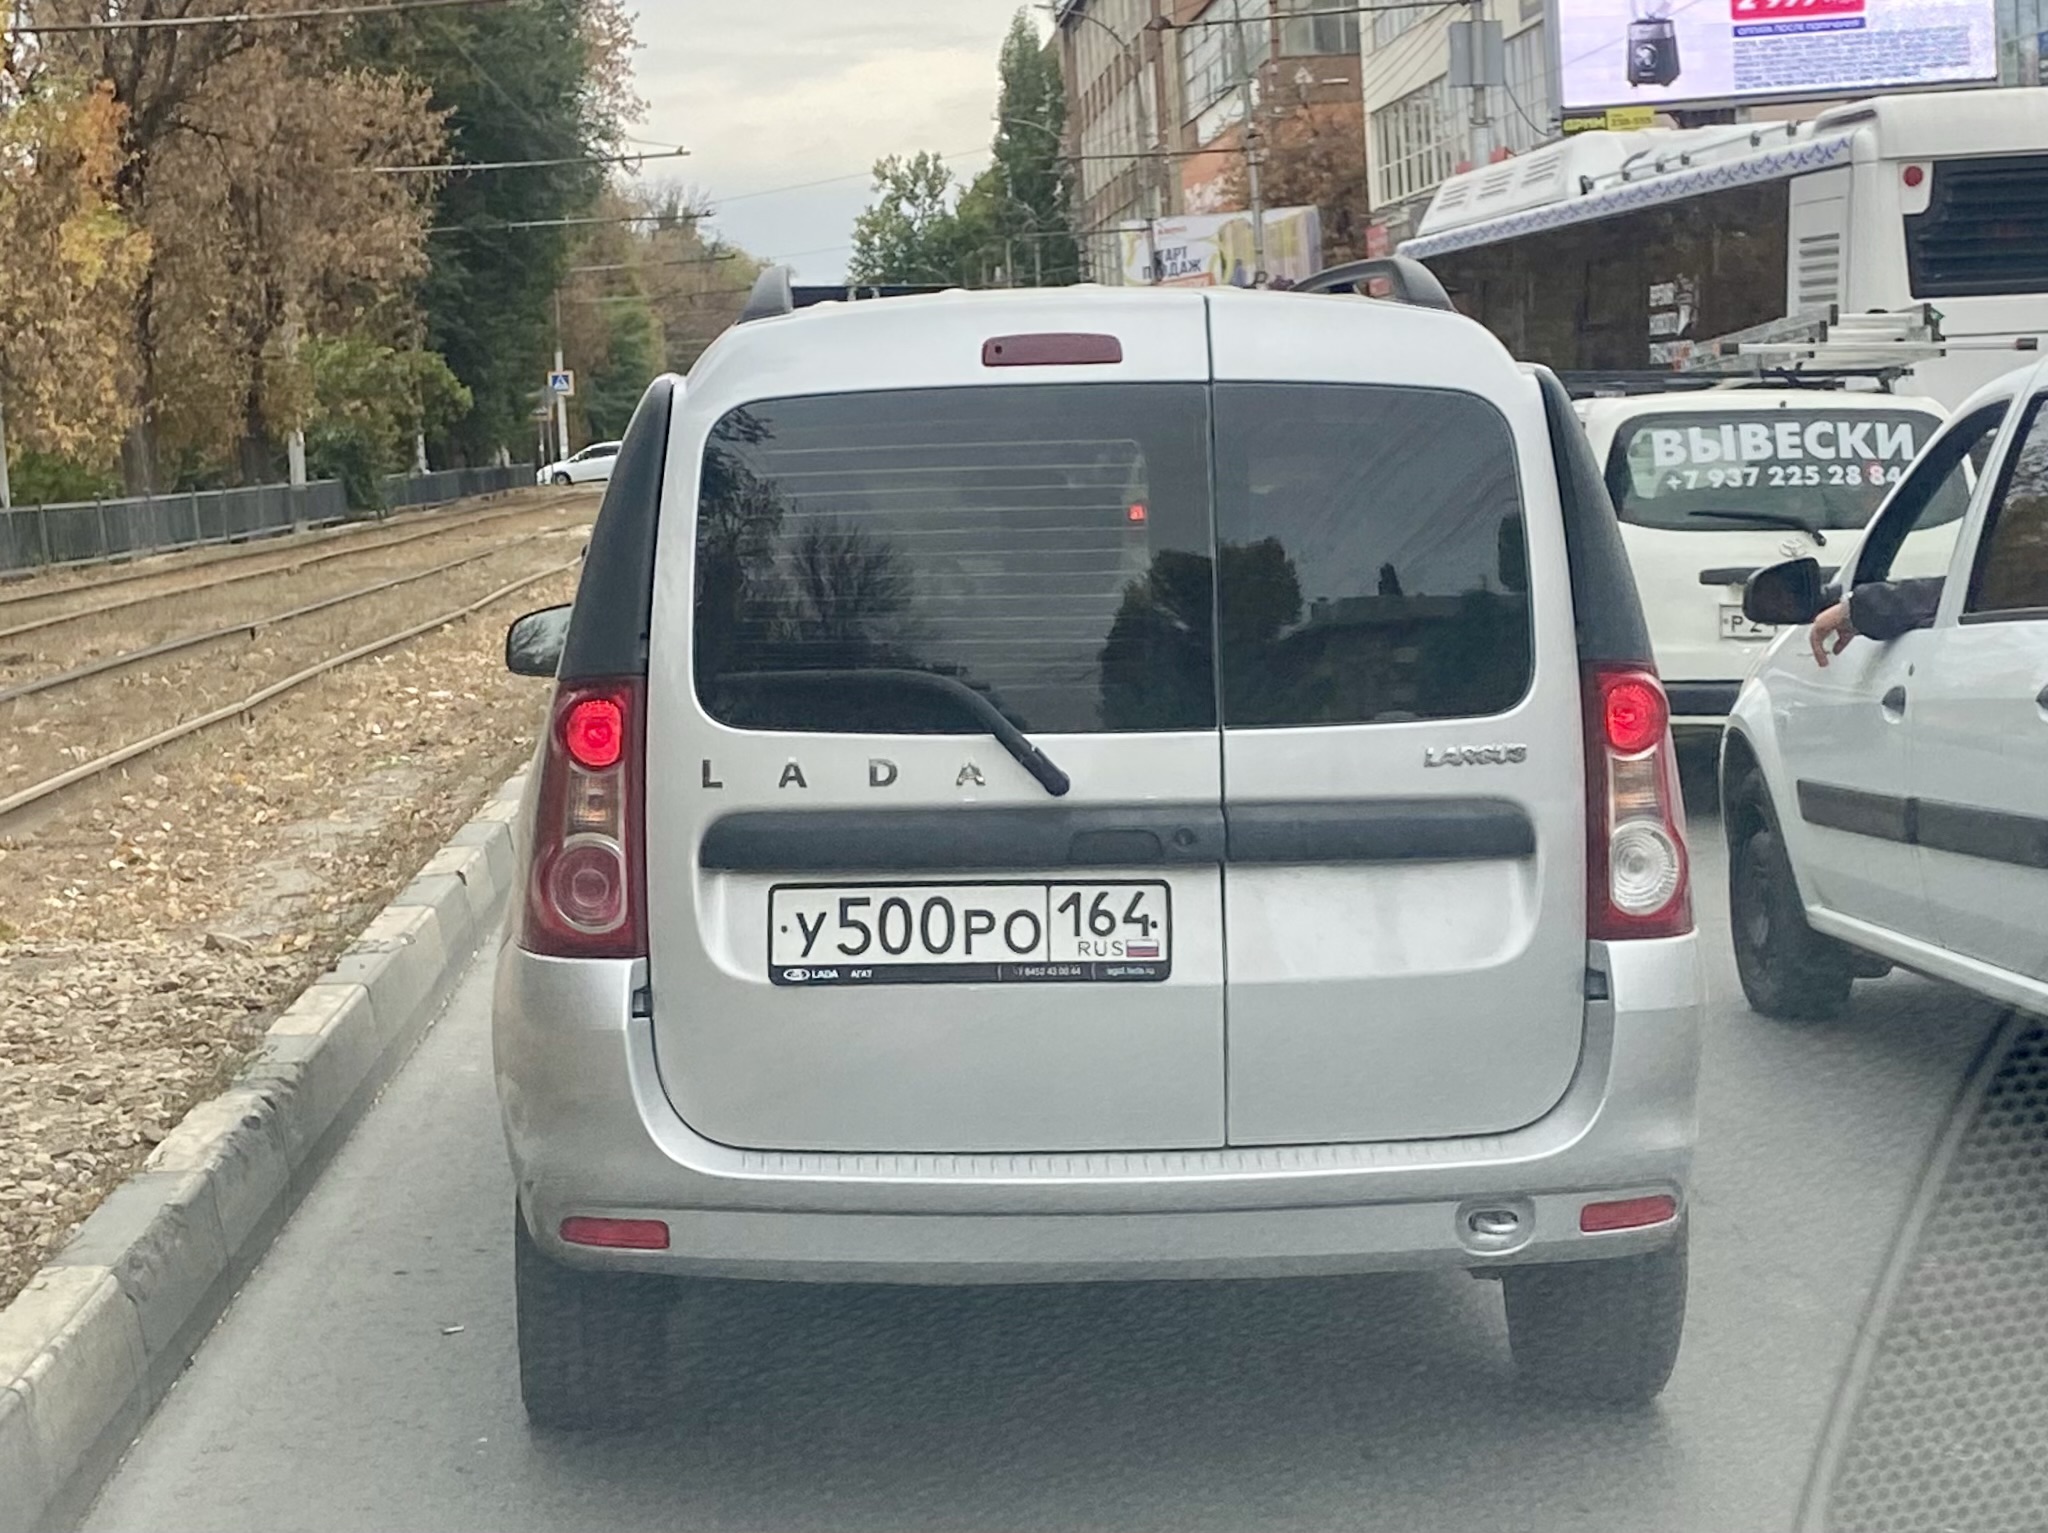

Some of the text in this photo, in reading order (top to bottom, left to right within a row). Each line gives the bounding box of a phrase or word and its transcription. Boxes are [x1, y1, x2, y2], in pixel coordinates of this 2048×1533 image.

[1651, 421, 1915, 467] ВЫВЕСКИ
[1666, 470, 1699, 491] +7
[1707, 466, 1760, 489] 937
[1768, 465, 1821, 487] 225
[1828, 464, 1863, 486] 28
[1424, 742, 1528, 768] LARGUS
[702, 757, 986, 789] LADA
[796, 895, 1042, 958] У500РО
[1057, 890, 1150, 938] 164
[1078, 940, 1124, 957] RUS
[811, 969, 839, 979] LADA
